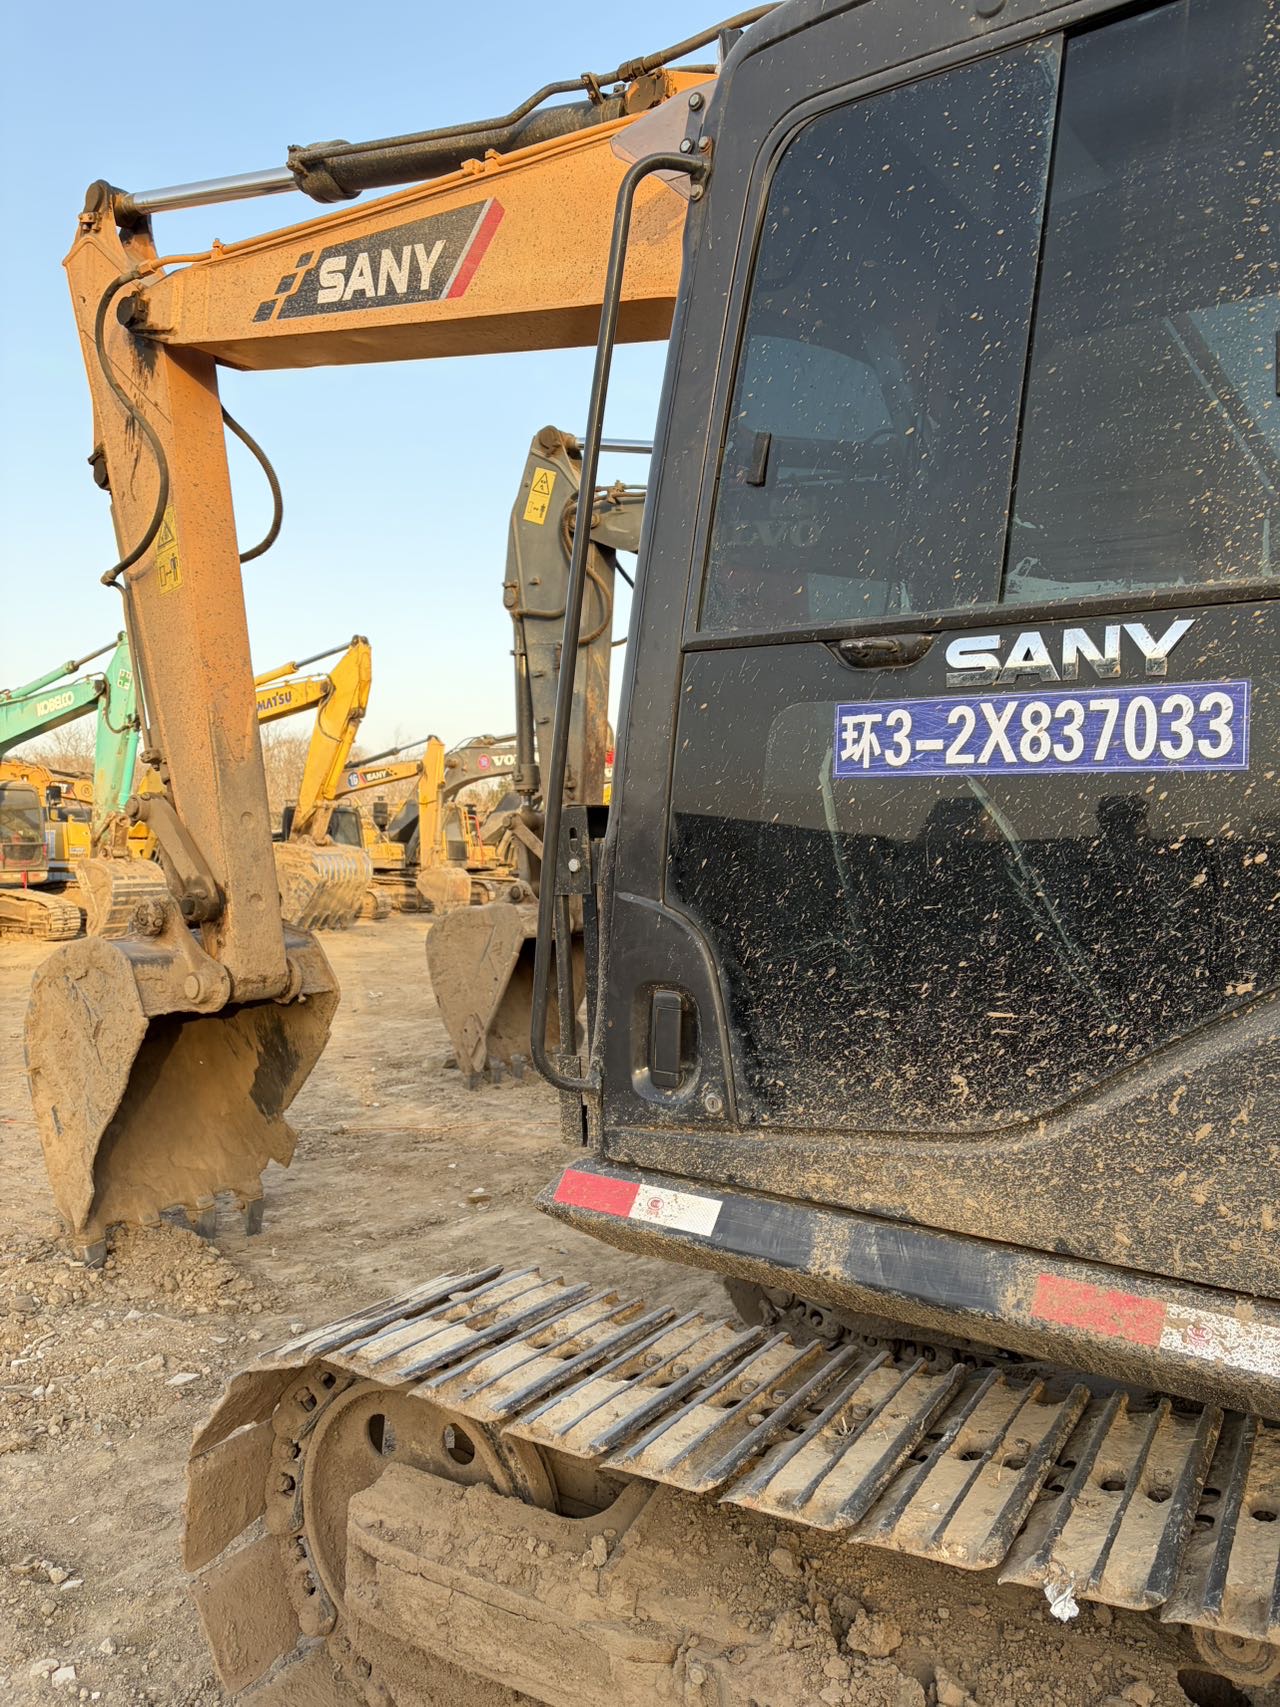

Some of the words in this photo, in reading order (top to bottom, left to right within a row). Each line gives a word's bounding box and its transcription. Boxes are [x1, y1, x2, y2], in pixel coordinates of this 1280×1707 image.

[317, 239, 447, 304] SANY
[945, 618, 1196, 688] SANY
[36, 691, 75, 717] KOBELCO
[257, 691, 292, 711] MATSU
[840, 691, 1235, 769] 环3-2X837033
[366, 770, 387, 781] SANY
